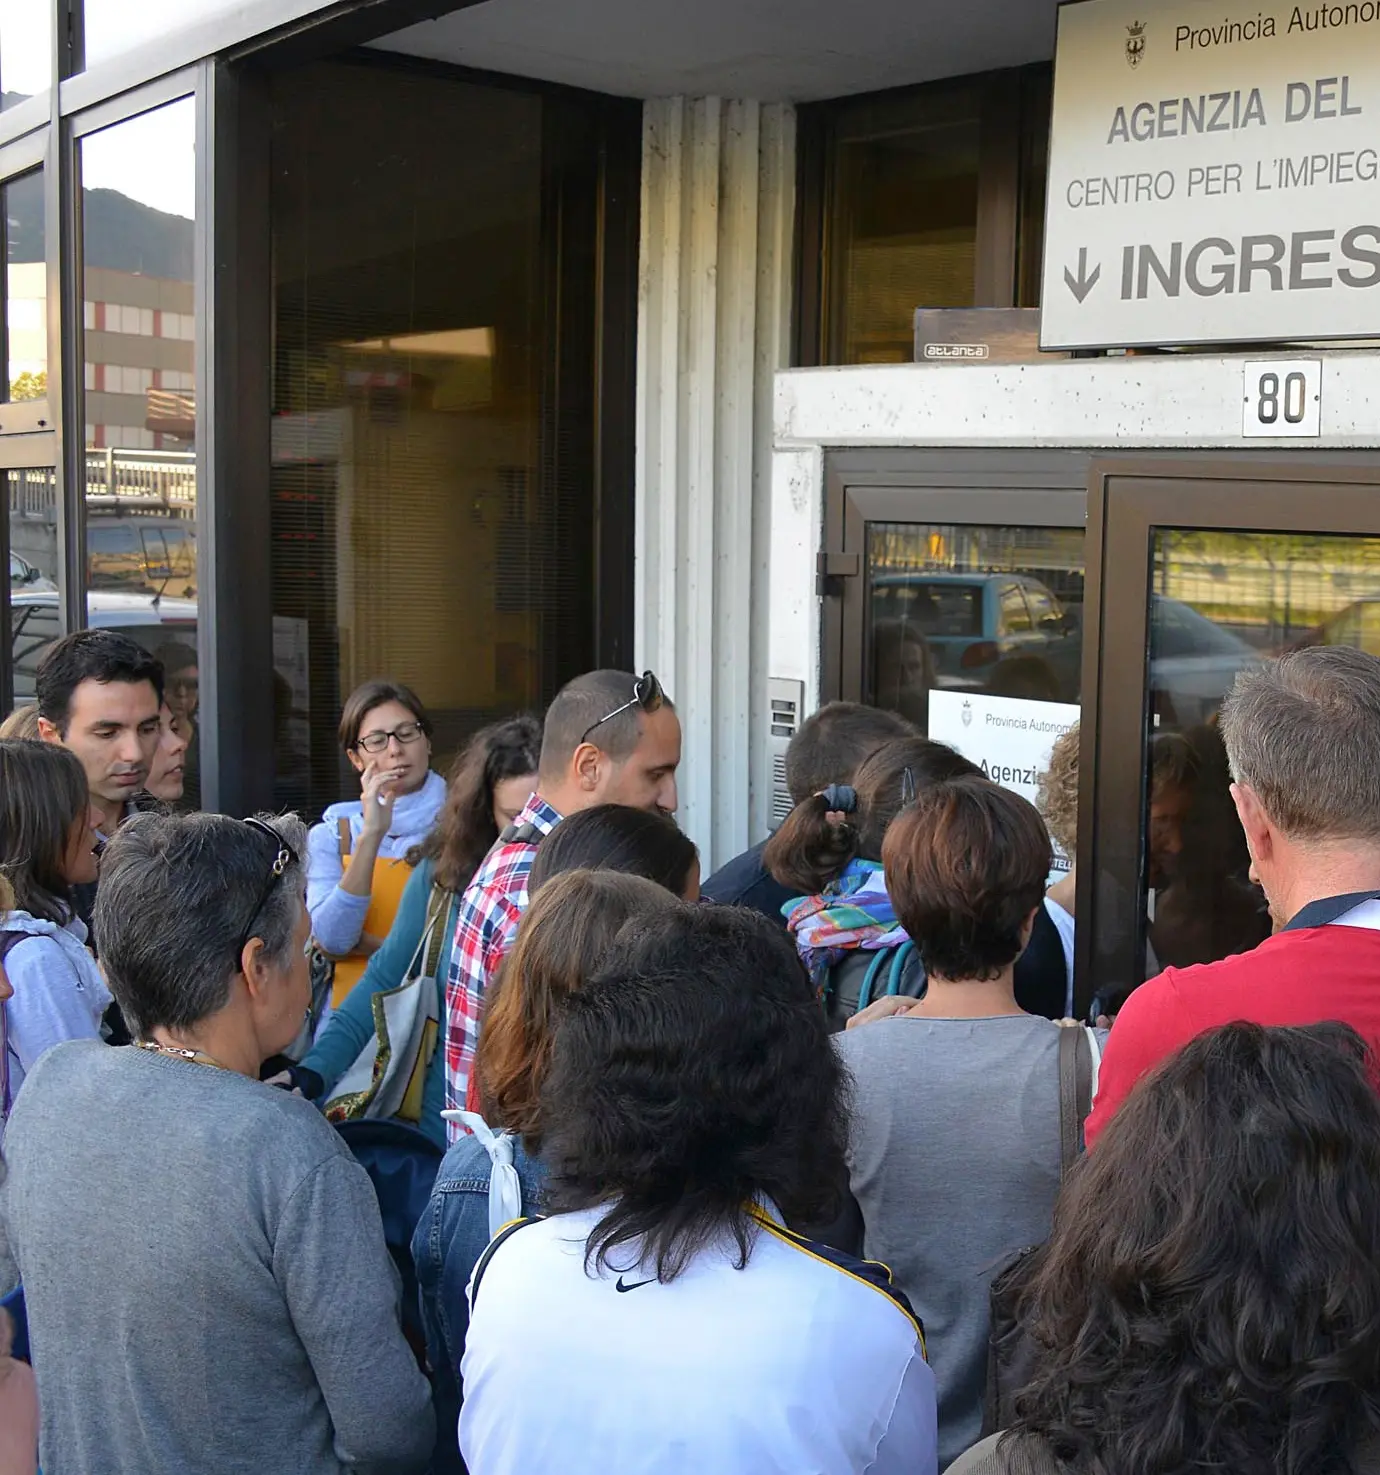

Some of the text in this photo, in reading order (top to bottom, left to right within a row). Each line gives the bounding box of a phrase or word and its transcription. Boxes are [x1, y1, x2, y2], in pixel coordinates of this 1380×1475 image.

[1175, 13, 1276, 51] Provincia
[1107, 88, 1267, 145] AGENZIA
[1285, 77, 1362, 123] DEL
[1066, 170, 1176, 209] CENTRO
[1187, 163, 1243, 199] PER
[927, 346, 984, 356] atlanta
[1257, 372, 1306, 425] 80
[985, 713, 1027, 730] Provincia
[980, 758, 1044, 785] Agenzi
